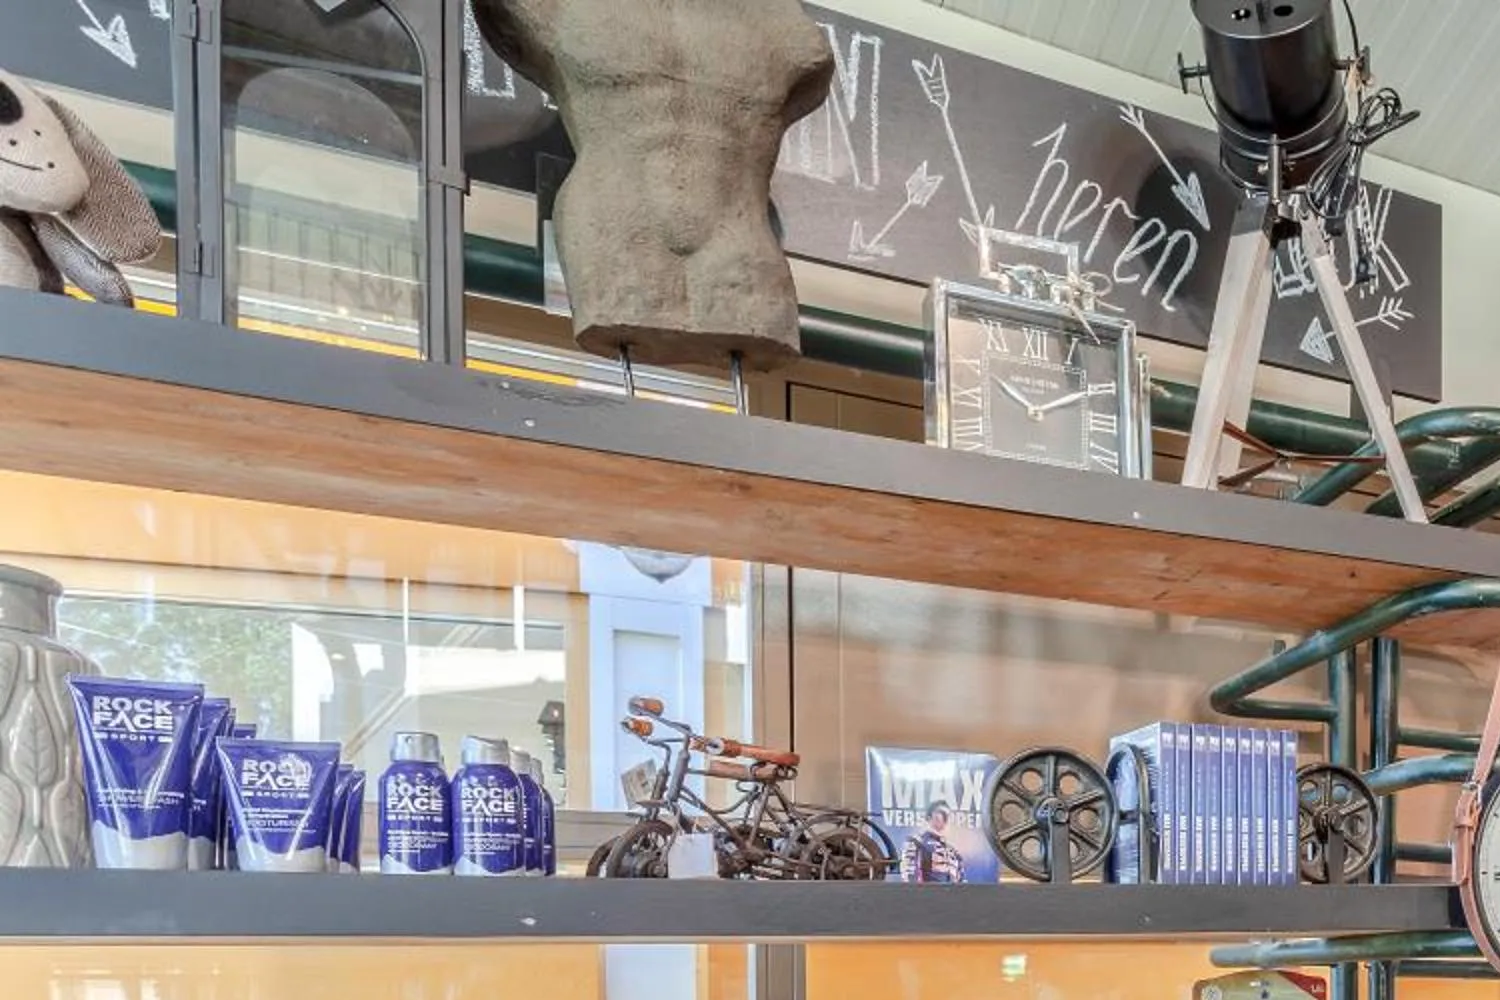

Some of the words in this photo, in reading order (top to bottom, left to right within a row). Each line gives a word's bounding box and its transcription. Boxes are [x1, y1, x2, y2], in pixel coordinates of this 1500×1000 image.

[1016, 123, 1198, 312] heren
[93, 696, 172, 714] ROCK
[93, 711, 173, 732] FACE
[387, 784, 443, 799] ROCK
[881, 760, 984, 809] MAX
[461, 786, 518, 802] ROCK
[386, 797, 444, 813] FACE
[461, 799, 516, 816] FACE
